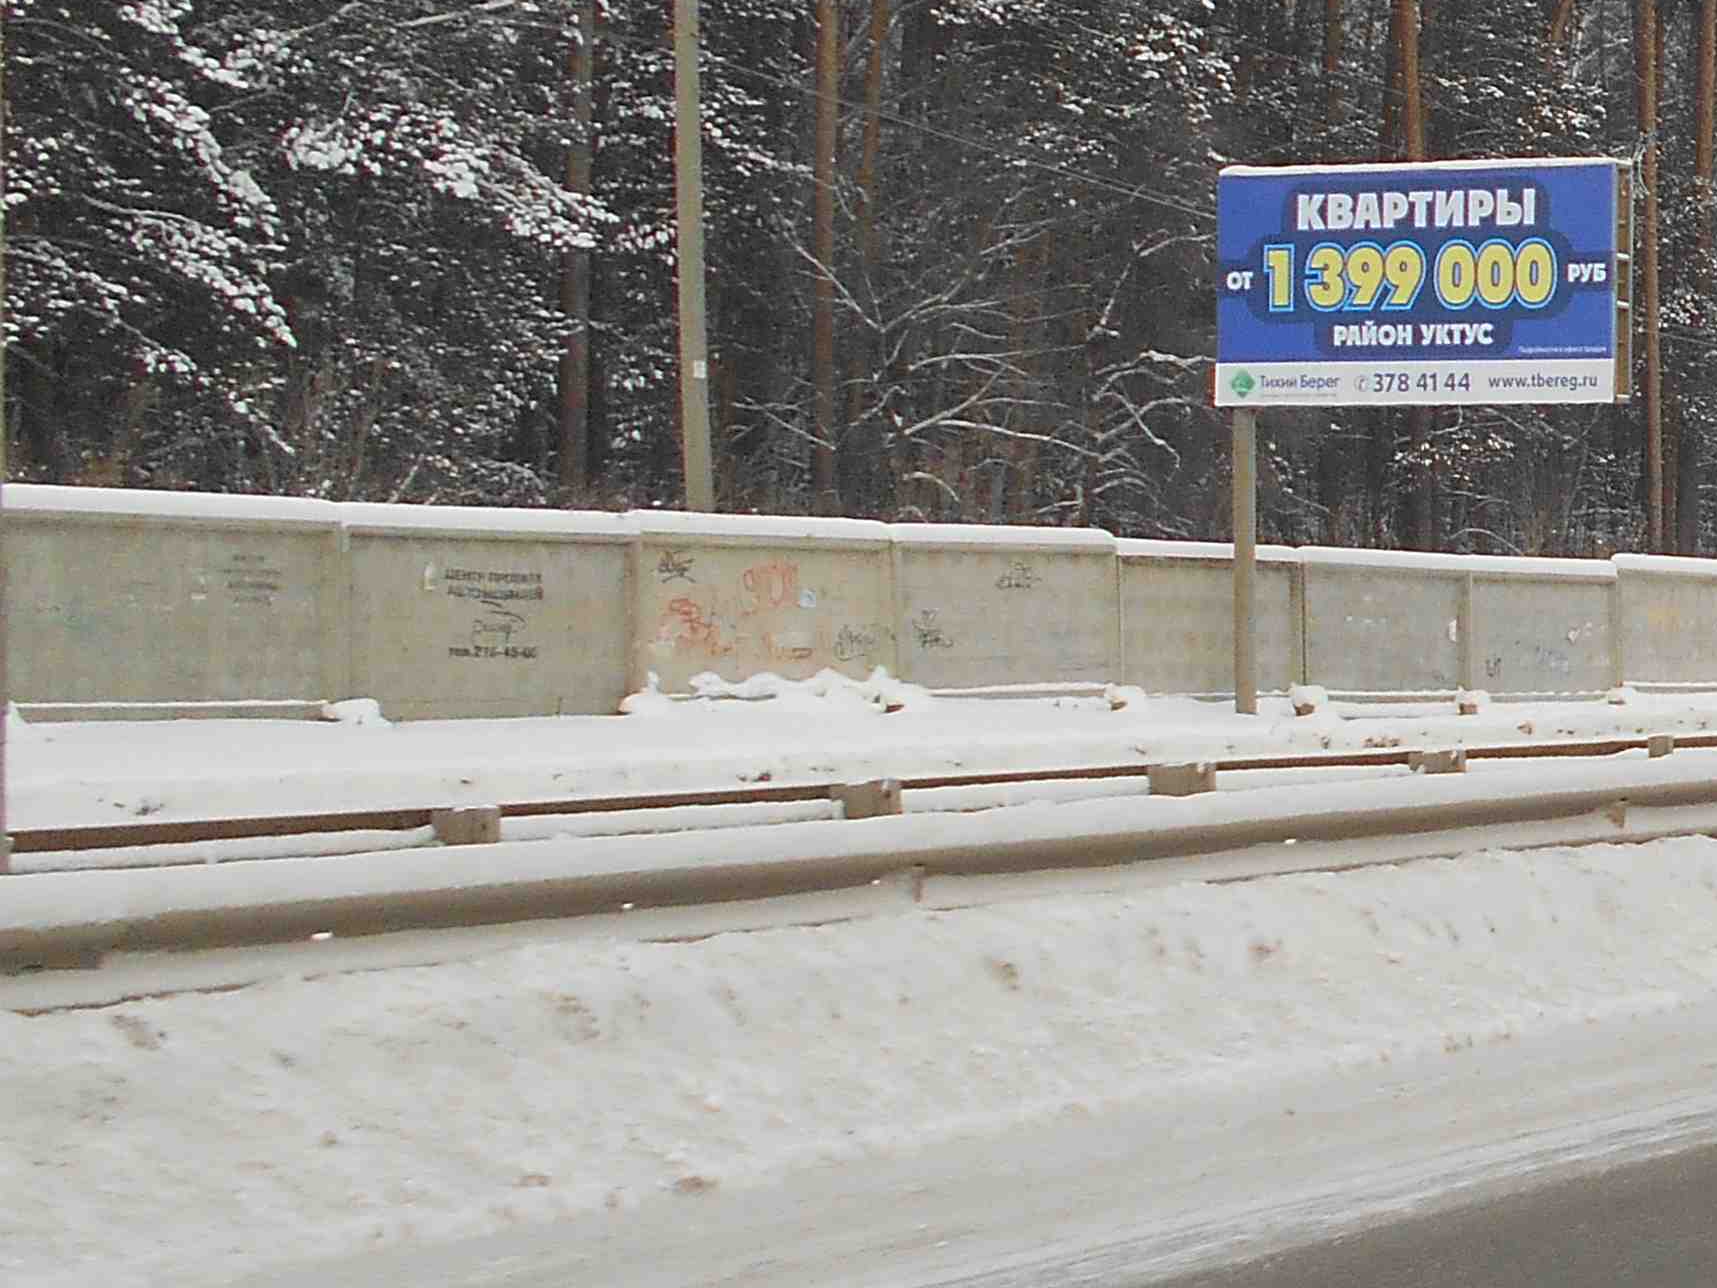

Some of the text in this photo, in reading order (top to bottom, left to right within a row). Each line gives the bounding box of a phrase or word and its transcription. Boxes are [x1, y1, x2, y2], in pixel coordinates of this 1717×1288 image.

[1297, 188, 1536, 231] КВАРТИРЫ
[1263, 242, 1295, 312] 1
[1304, 240, 1426, 312] 399
[1433, 238, 1557, 310] 000
[1567, 262, 1607, 283] РУБ
[1333, 320, 1494, 347] РАЙОН УКТУС
[1260, 374, 1340, 391] Тихий Берег
[1373, 372, 1471, 393] 378 41 44
[1488, 372, 1598, 391] www.tbereg.ru
